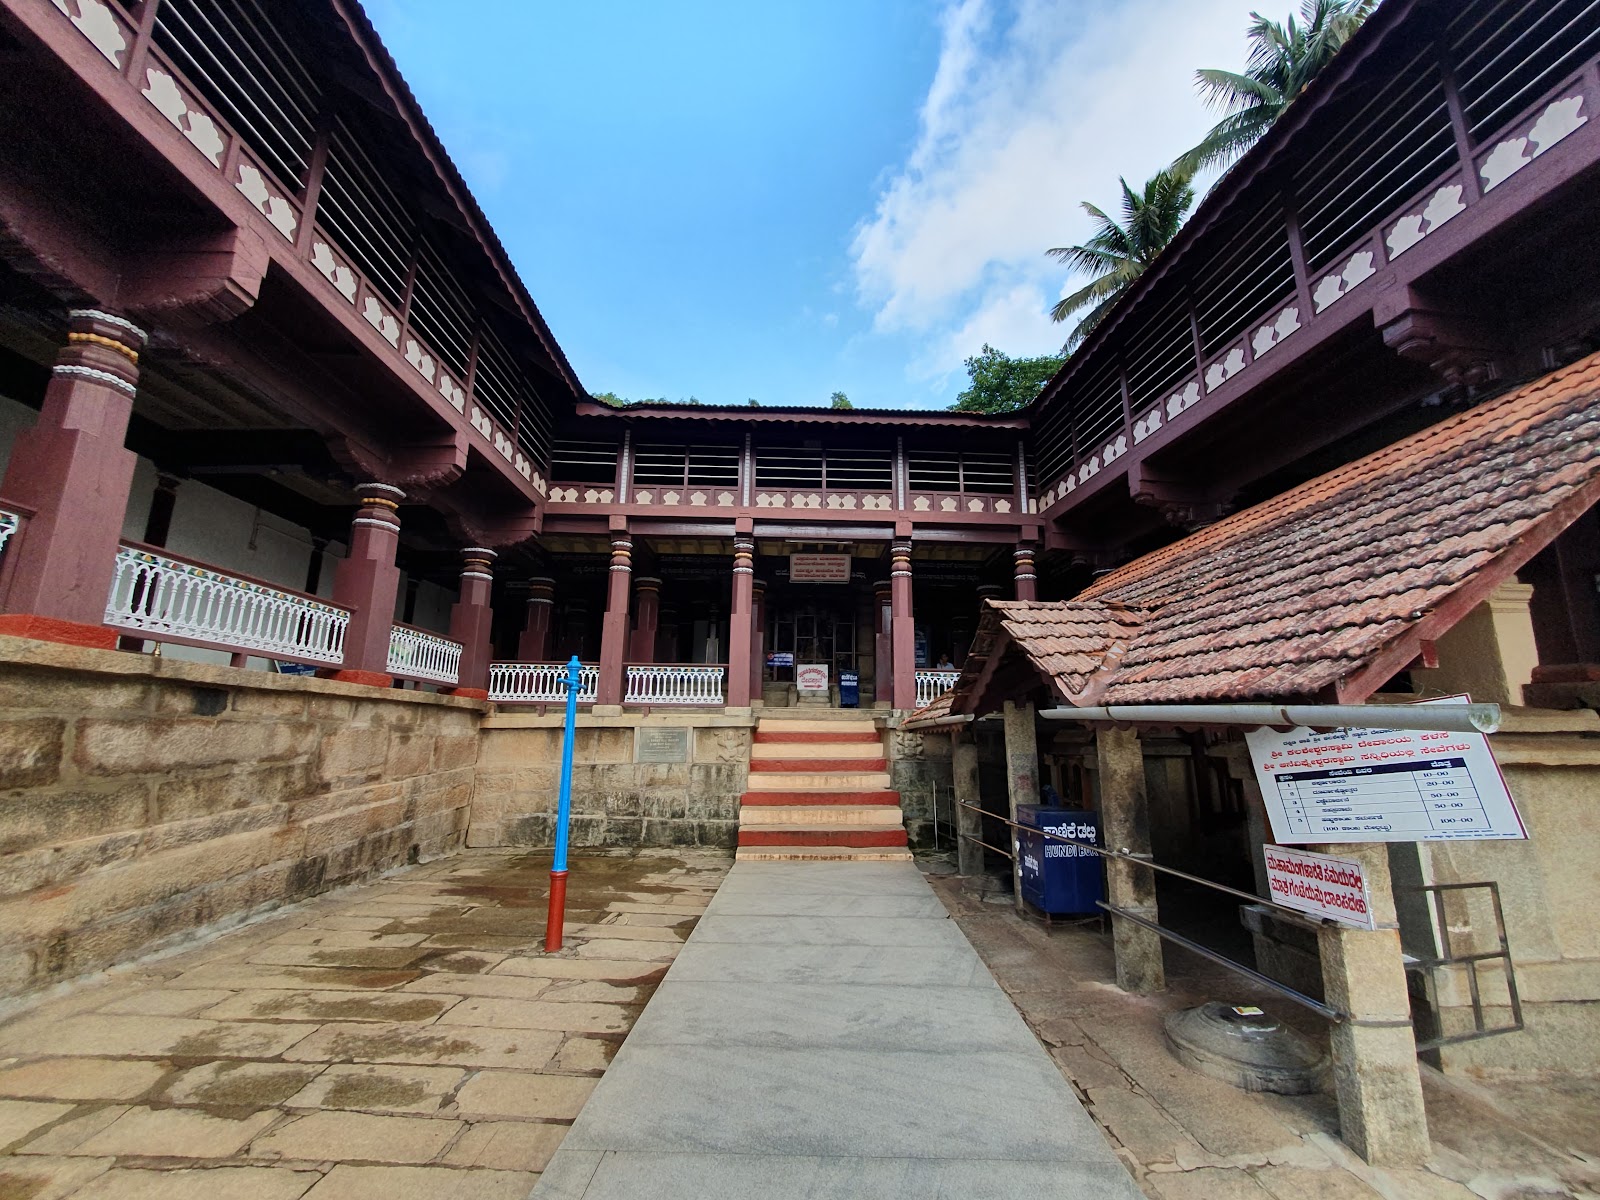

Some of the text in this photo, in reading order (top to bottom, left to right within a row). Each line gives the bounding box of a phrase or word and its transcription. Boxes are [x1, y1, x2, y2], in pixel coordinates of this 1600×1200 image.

[1263, 763, 1275, 771] ಶ್ರೀ
[1360, 749, 1415, 761] ಸನ್ನಿಧಿಯಲ್ಲಿ
[1420, 744, 1471, 754] ಸೇವೆಗಳು
[1270, 751, 1283, 759] ಶ್ರೀ
[1287, 743, 1353, 756] ಕಲಶೇಶ್ವರಸ್ವಾಮಿ
[1420, 732, 1449, 741] ಕಳಸ
[1077, 823, 1096, 842] ಡಬ್ಬಿ
[1045, 845, 1076, 857] HUNDI
[1267, 853, 1363, 892] ಮಹಾಮಂಗಳಾರತಿ ಸಮಯದಲ್ಲಿ
[1272, 875, 1366, 913] ಮಾತ್ರ ಗಂಟೆಯನ್ನು ಬಾರಿಸಬೇಕು
